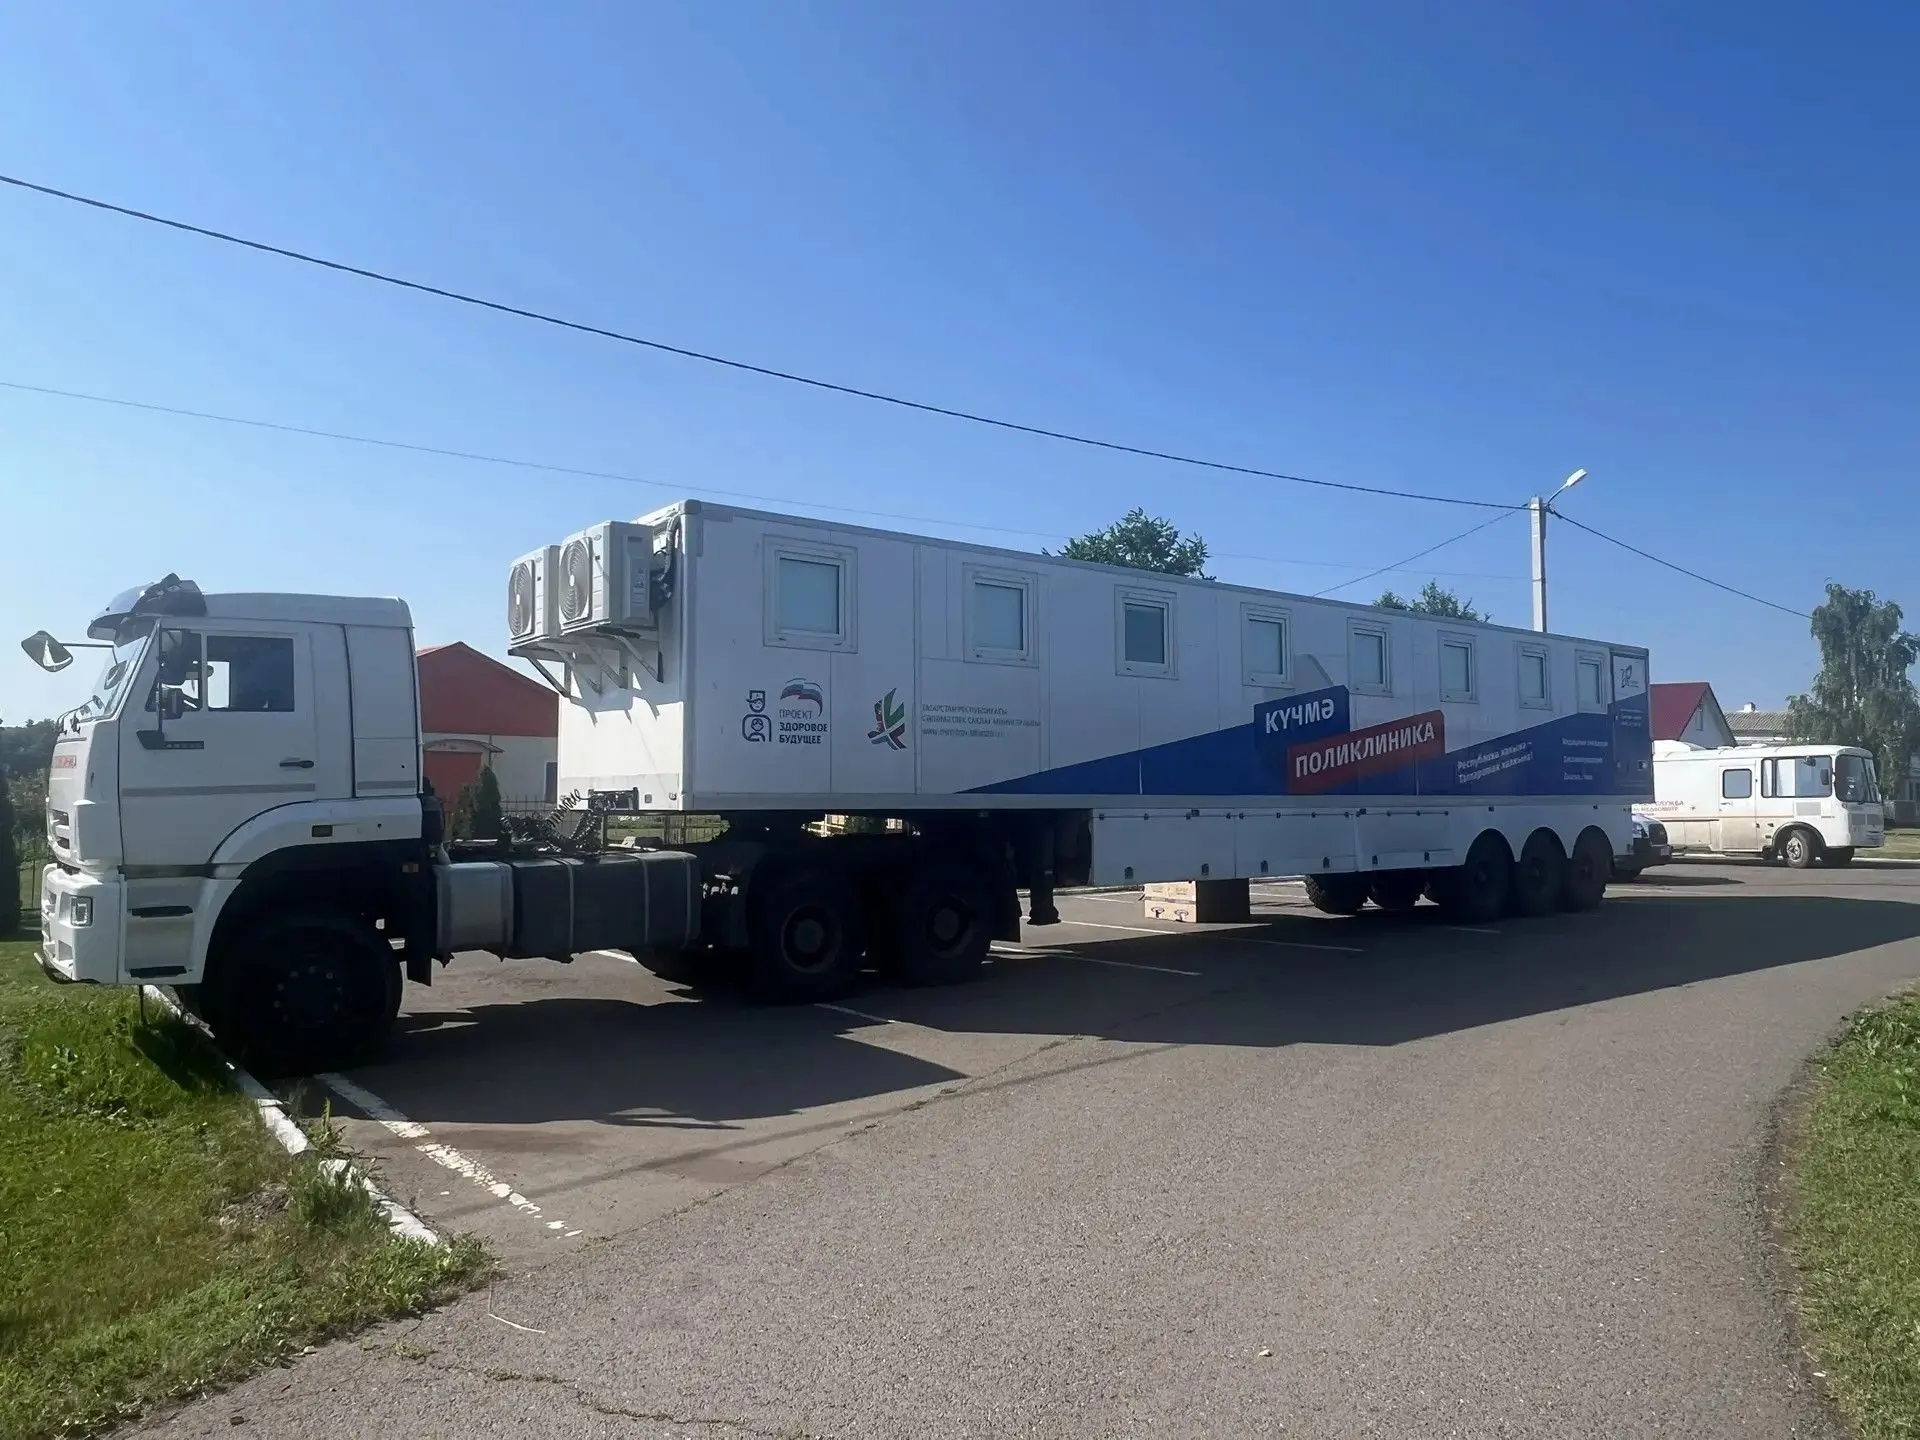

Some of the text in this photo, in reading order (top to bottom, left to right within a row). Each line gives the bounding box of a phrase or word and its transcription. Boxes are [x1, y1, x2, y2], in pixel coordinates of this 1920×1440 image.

[779, 709, 812, 719] ПРОЕКТ
[779, 721, 828, 732] ЗДОРОВОЕ
[779, 734, 822, 744] БУДУЩЕЕ
[1295, 721, 1435, 777] ПОЛИКЛИНИКА
